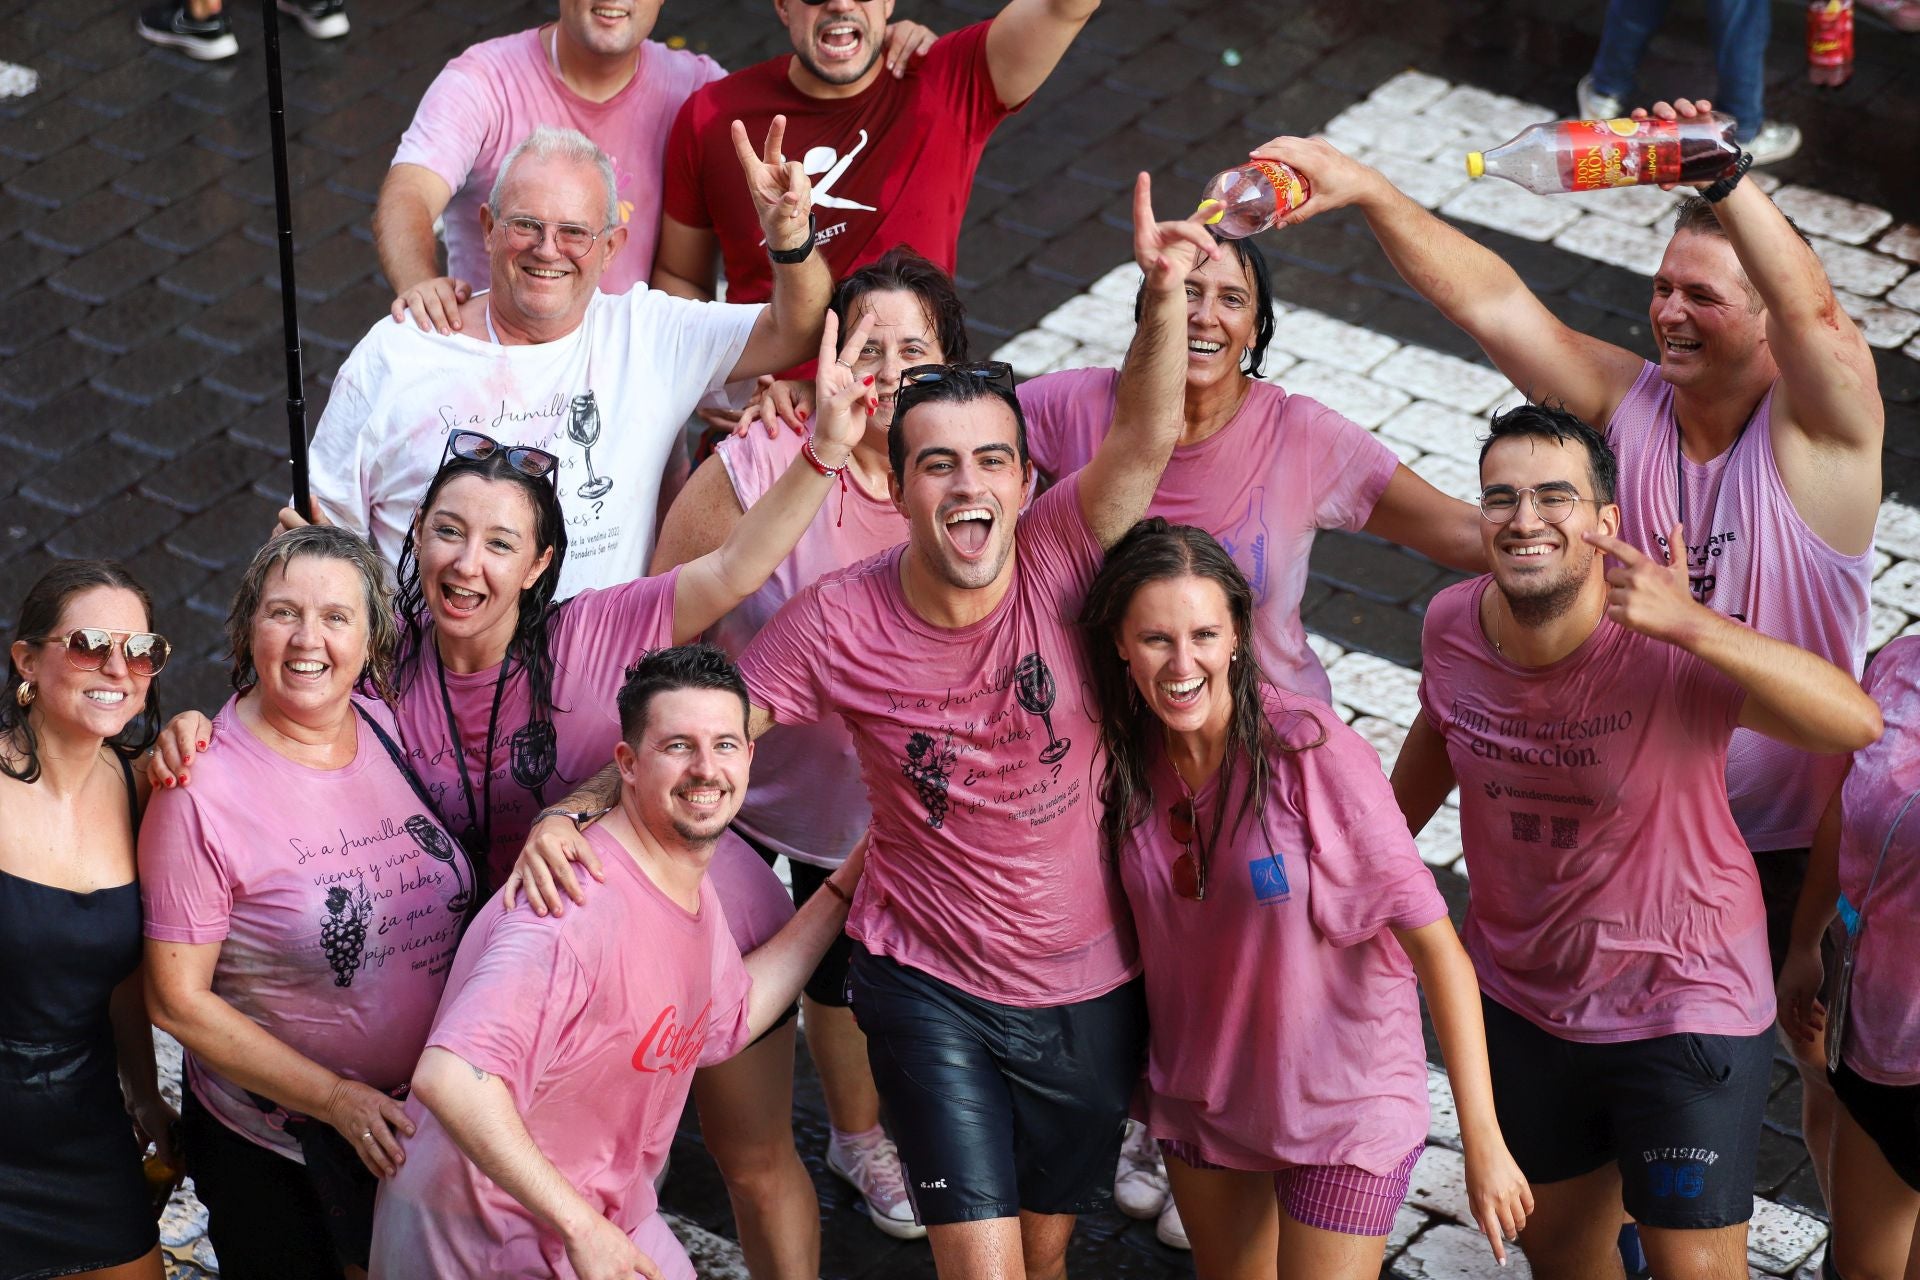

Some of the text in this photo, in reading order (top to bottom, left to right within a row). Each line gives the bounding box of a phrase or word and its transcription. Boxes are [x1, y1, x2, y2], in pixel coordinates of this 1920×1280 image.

[1577, 158, 1588, 184] DON
[1587, 145, 1602, 189] SIMON
[438, 393, 573, 435] Si a Jumill
[887, 665, 1014, 714] Si a Jumill
[964, 721, 977, 737] y
[983, 703, 1015, 724] vino
[1499, 718, 1528, 738] un
[1535, 709, 1633, 741] artesano
[960, 724, 1033, 755] no bebes
[1470, 738, 1602, 768] en acción.
[996, 759, 1029, 784] que
[1067, 778, 1080, 796] 2022
[1504, 785, 1595, 807] Vandemoortele
[1058, 801, 1067, 816] San
[289, 817, 409, 865] Si a Jumilla
[313, 848, 421, 887] vienes y vino
[373, 865, 444, 902] no bebes
[405, 903, 438, 931] que
[363, 945, 396, 970] pijo
[1643, 1147, 1719, 1166] DIVISION
